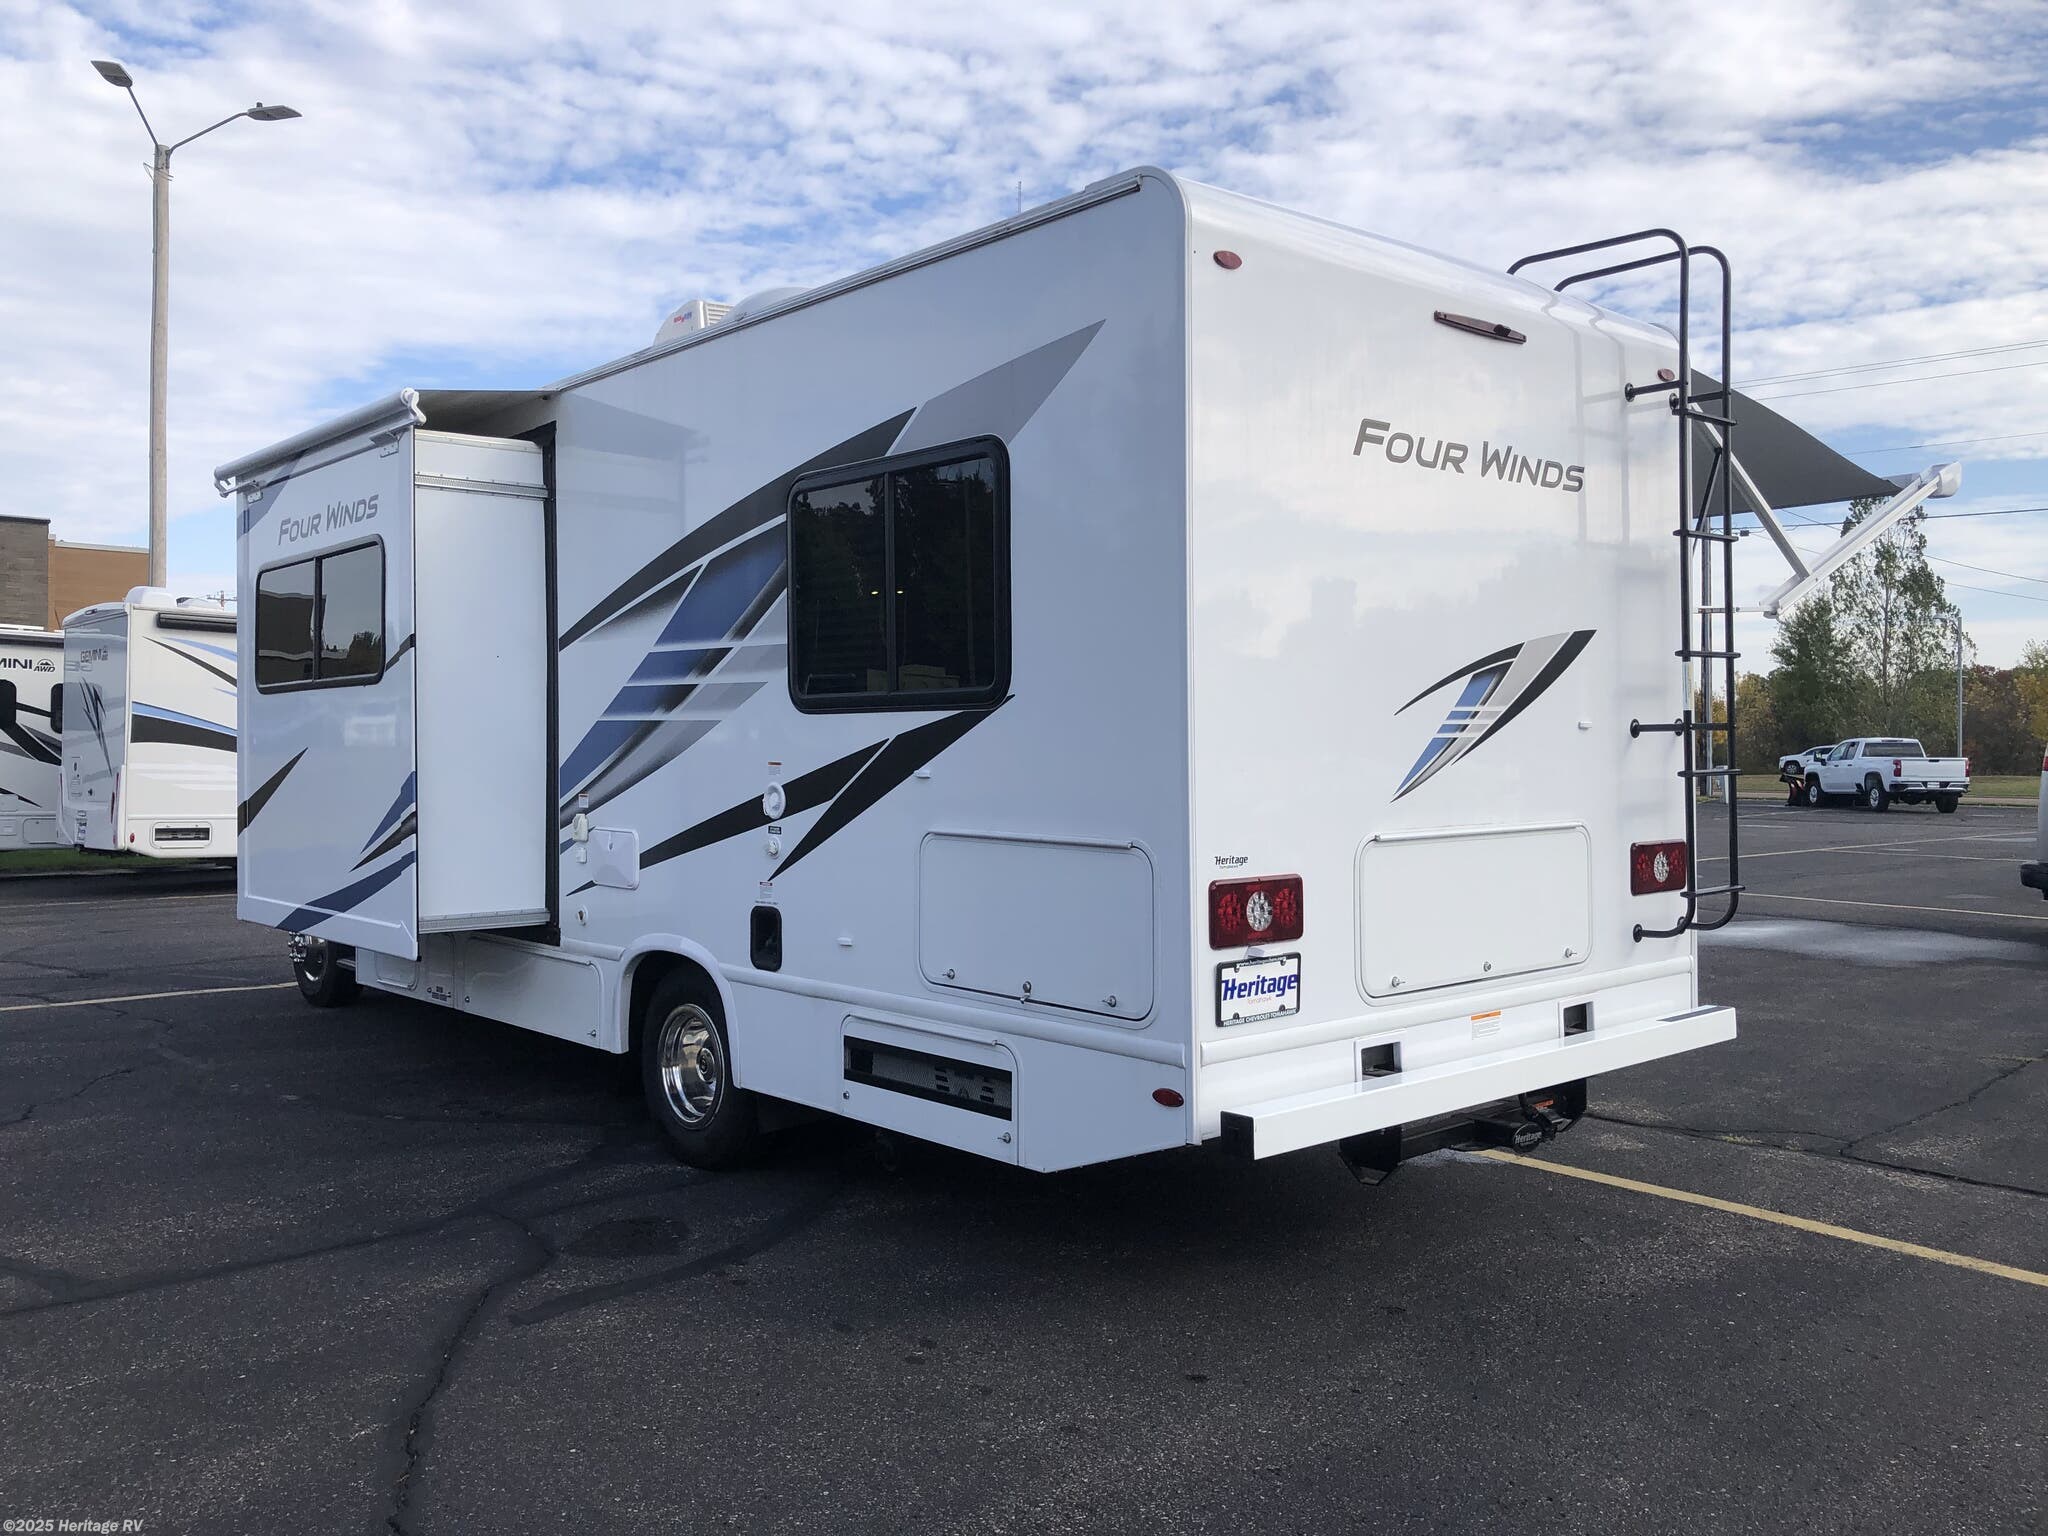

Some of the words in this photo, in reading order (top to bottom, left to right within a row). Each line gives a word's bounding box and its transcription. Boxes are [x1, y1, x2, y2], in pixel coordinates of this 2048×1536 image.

[1353, 418, 1468, 474] FOUR
[1481, 441, 1585, 493] WINDS
[278, 513, 321, 546] FOUR
[326, 494, 379, 532] WINDS
[1214, 855, 1249, 866] Heritage
[1221, 974, 1299, 1001] Heritage
[1514, 1131, 1543, 1144] Heritage
